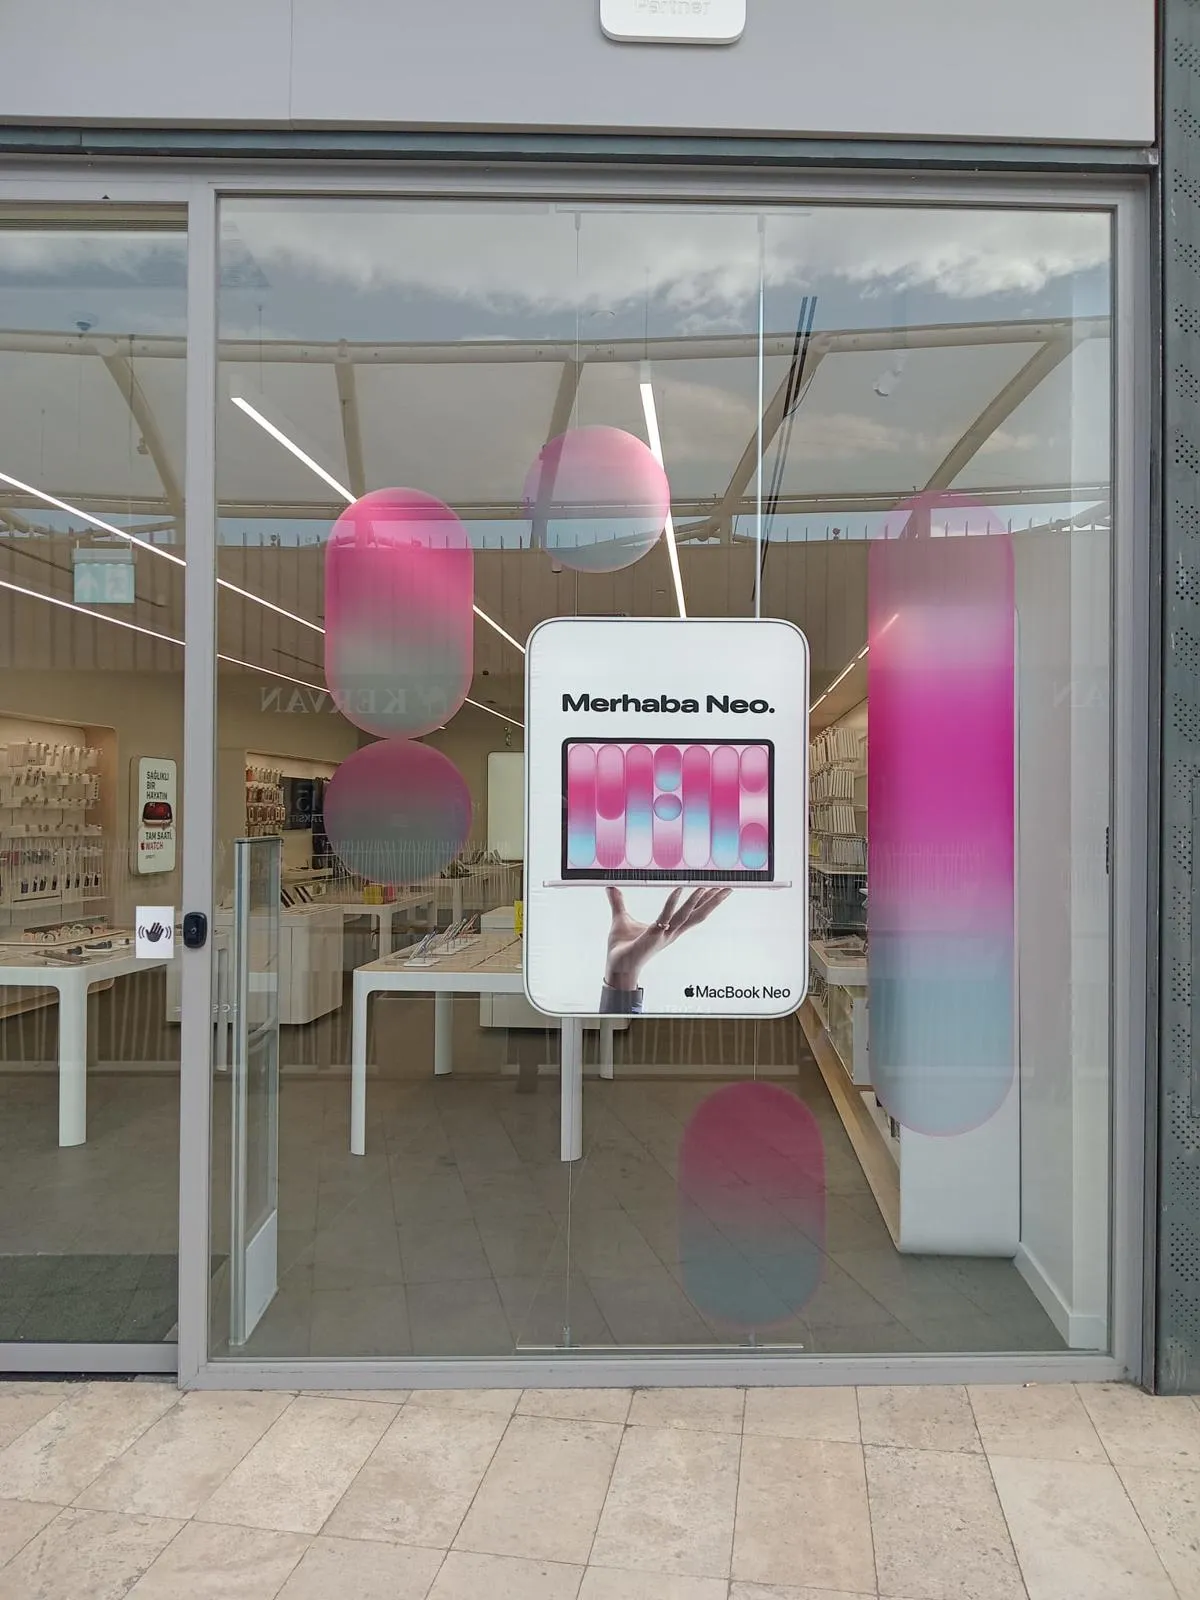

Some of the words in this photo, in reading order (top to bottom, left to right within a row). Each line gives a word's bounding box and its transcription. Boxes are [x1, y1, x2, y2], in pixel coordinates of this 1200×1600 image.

[562, 693, 699, 713] Merhaba
[706, 695, 776, 713] Neo.
[696, 985, 760, 998] MacBook
[762, 986, 791, 998] Neo
